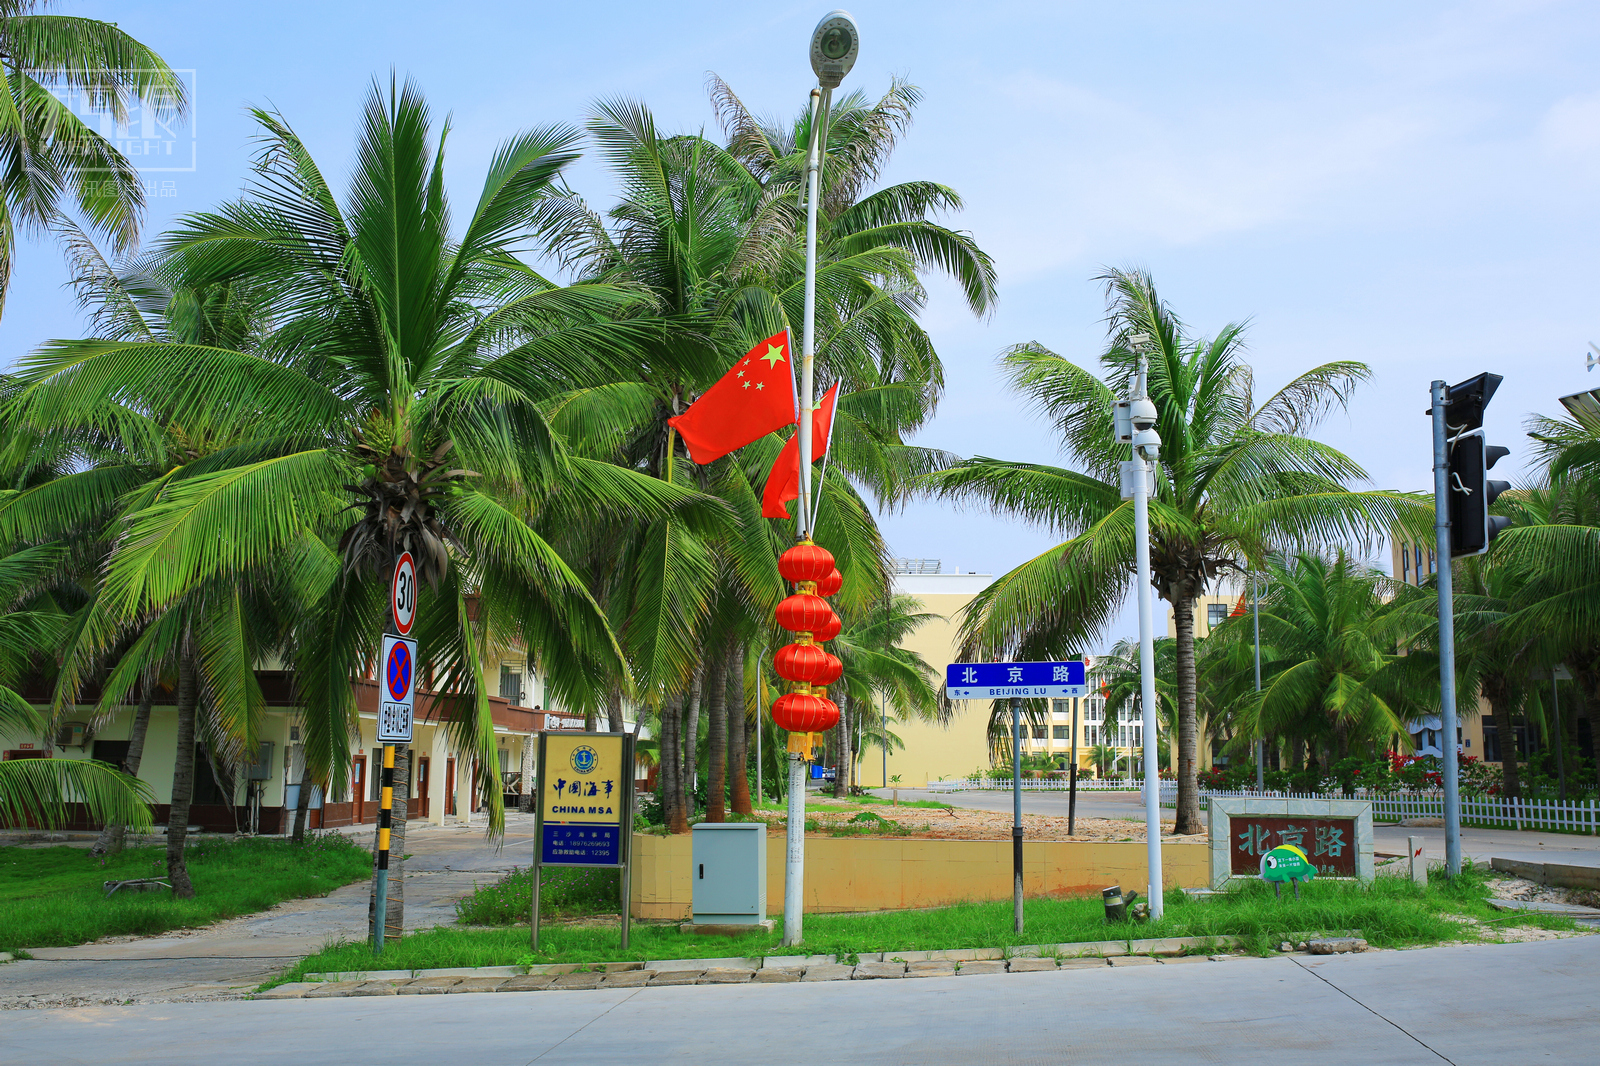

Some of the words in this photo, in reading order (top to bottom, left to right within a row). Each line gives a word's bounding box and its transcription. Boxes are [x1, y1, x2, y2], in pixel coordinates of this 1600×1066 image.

[397, 571, 413, 613] 30
[961, 665, 1070, 684] 北京路
[989, 688, 1029, 696] BEIJING
[552, 805, 585, 814] CHINA
[588, 806, 613, 815] MSA
[1238, 823, 1347, 857] 北京路
